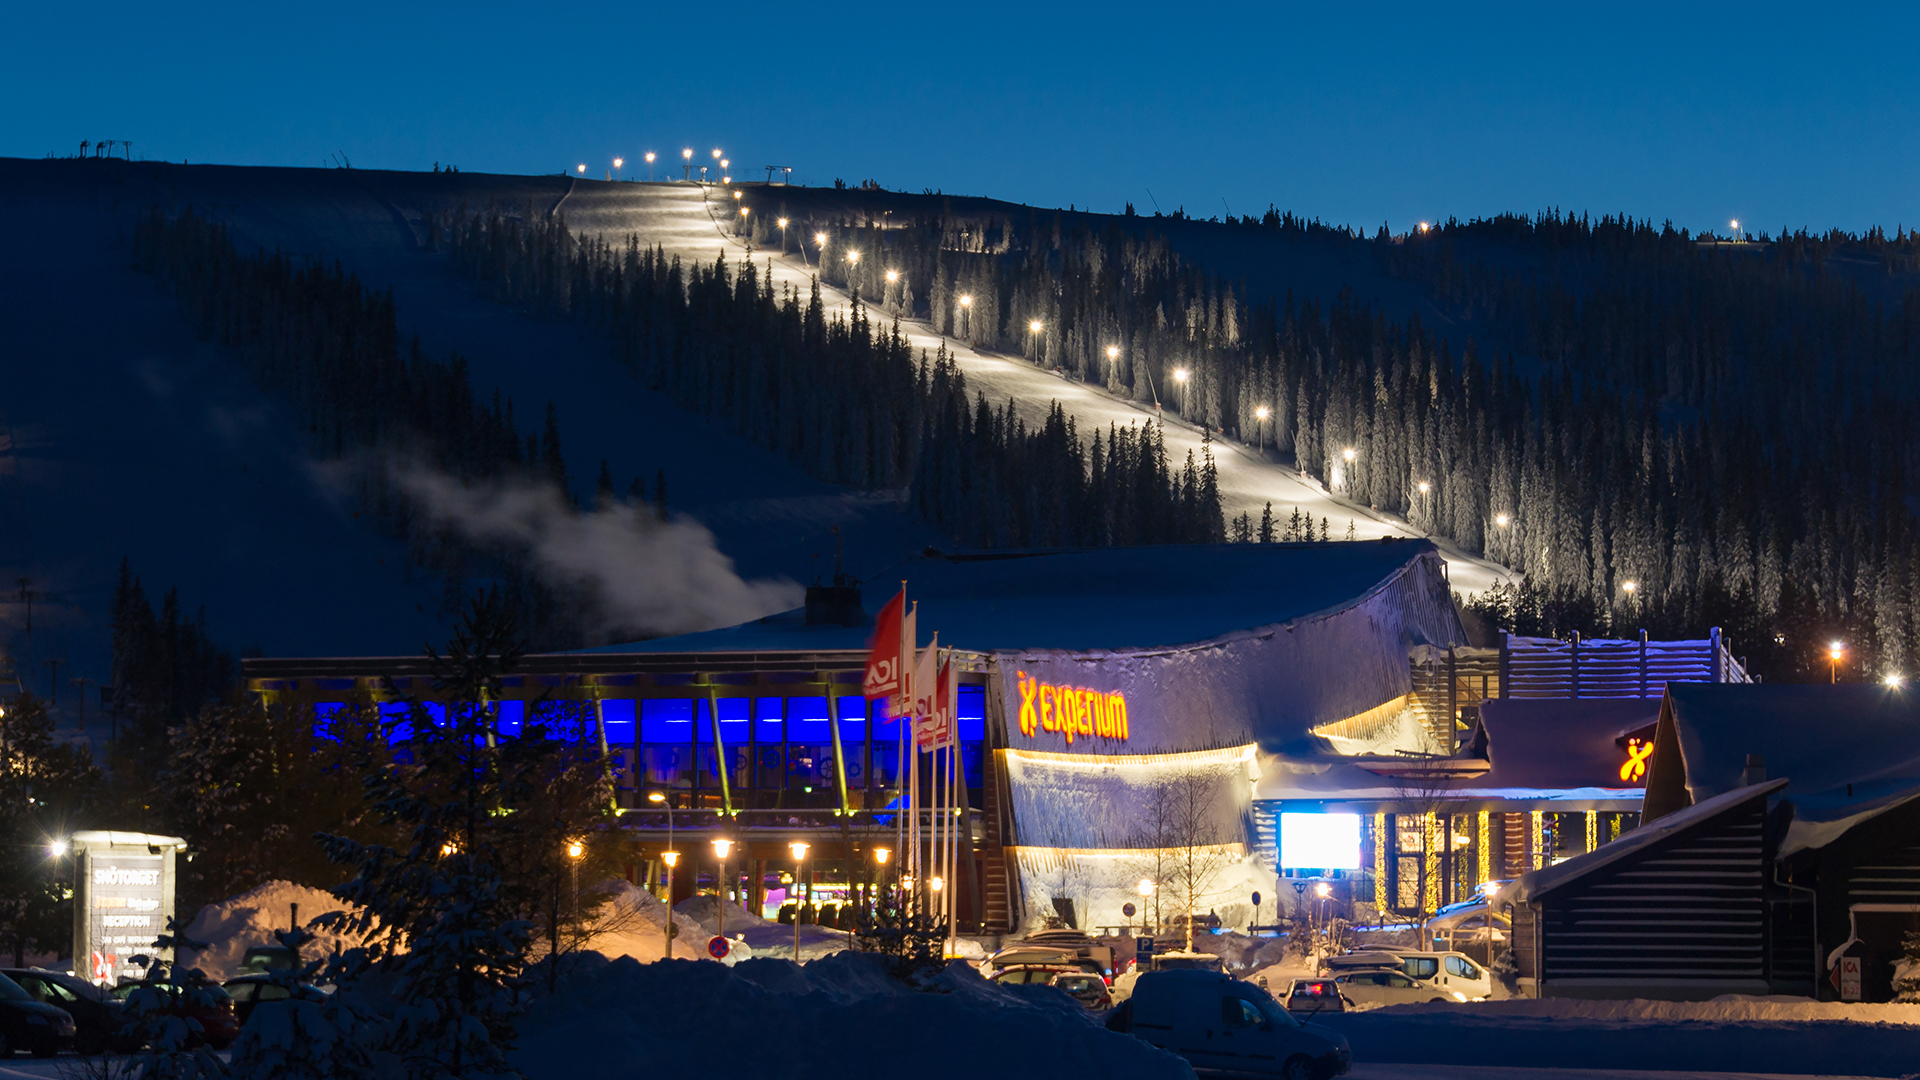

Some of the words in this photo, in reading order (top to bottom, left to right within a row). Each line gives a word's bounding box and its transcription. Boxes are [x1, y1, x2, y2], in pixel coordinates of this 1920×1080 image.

[94, 866, 160, 886] SNÖTORGET
[102, 915, 151, 928] RECEPTION
[1141, 938, 1150, 951] P
[1843, 961, 1858, 973] ICA
